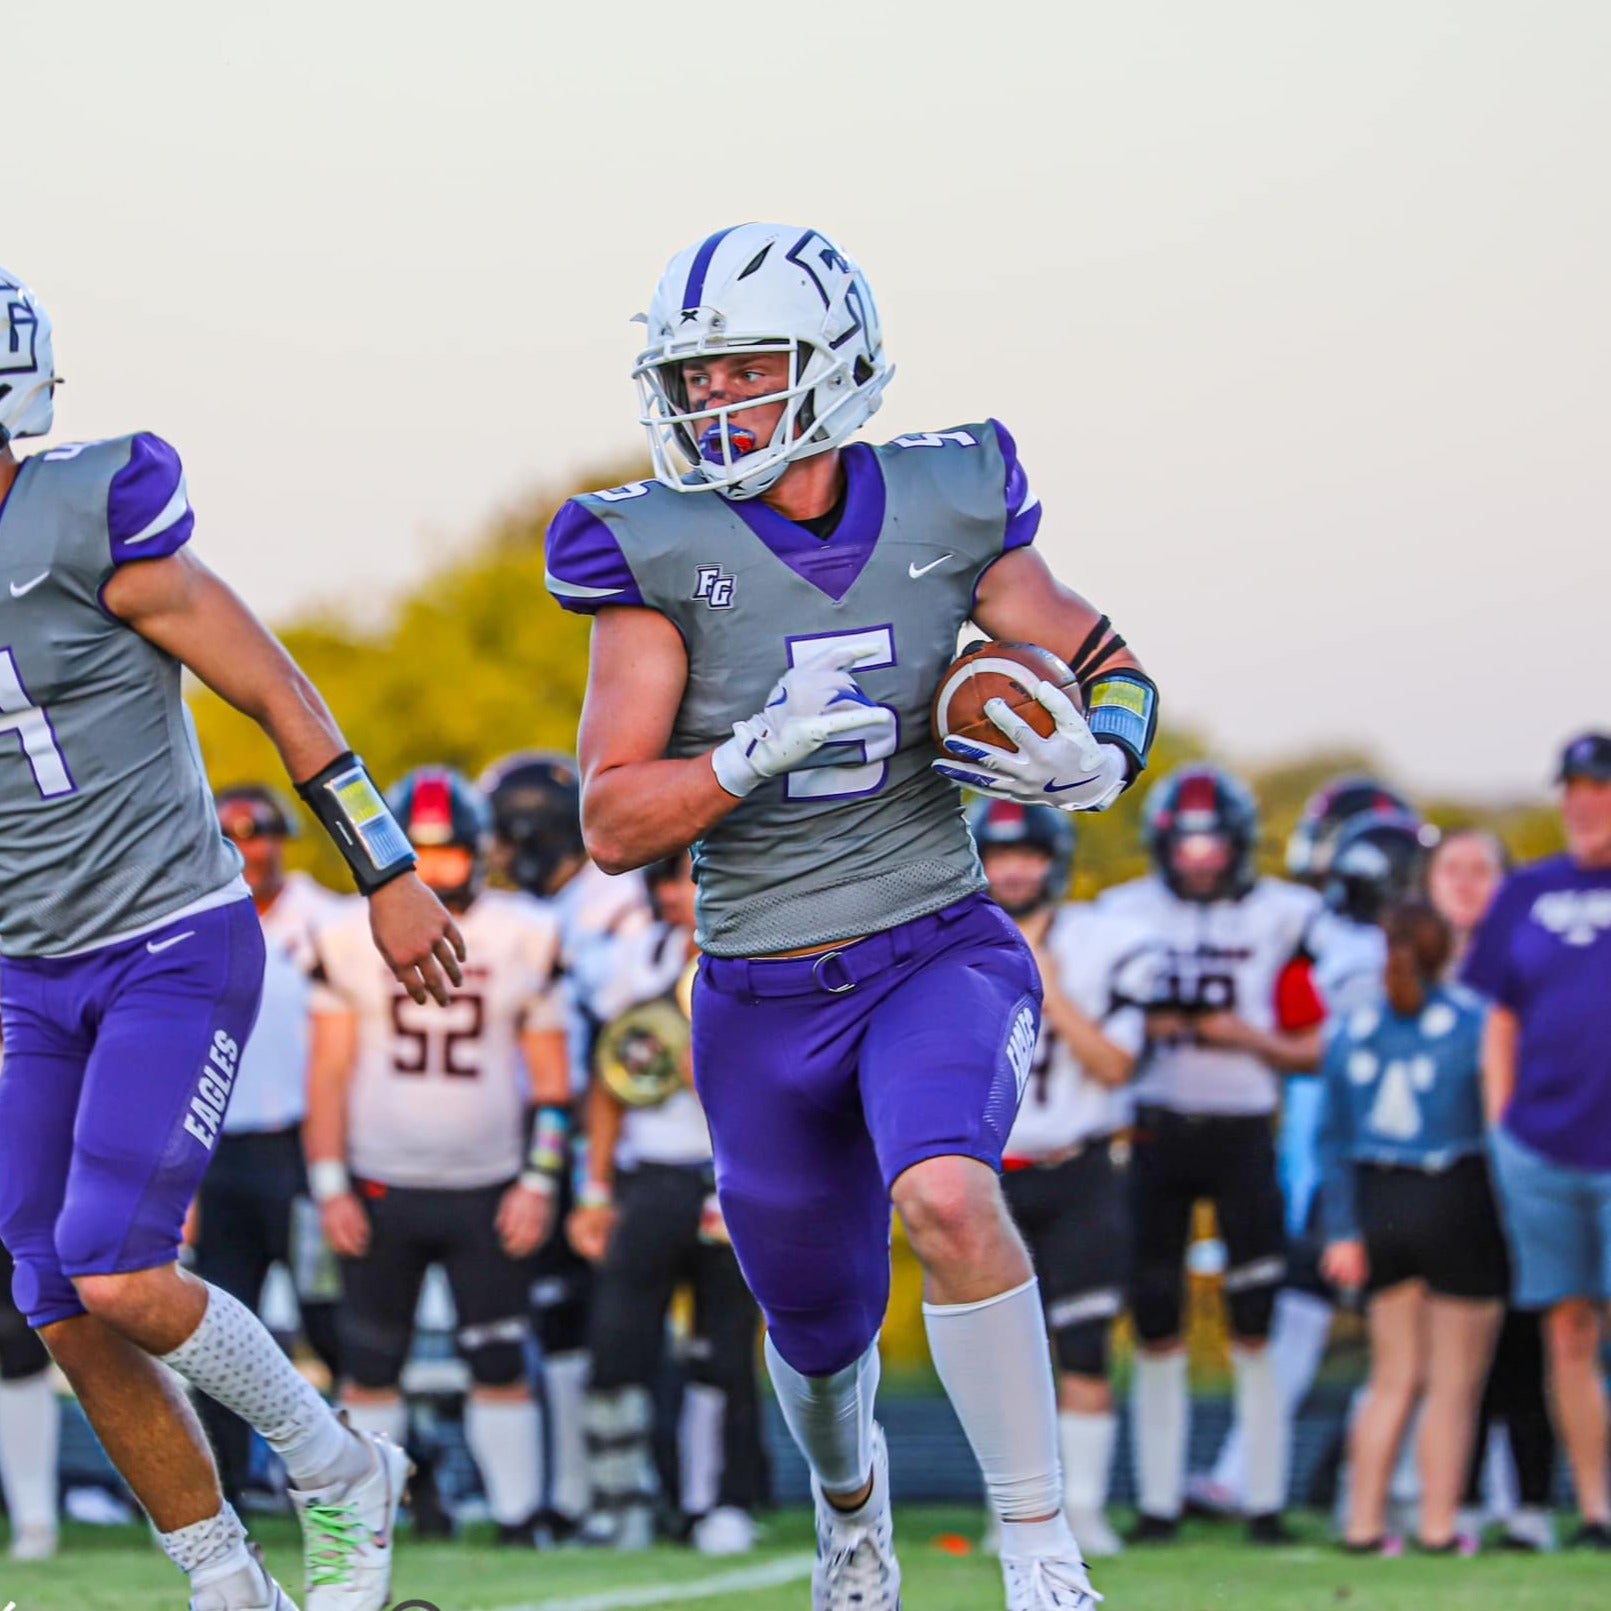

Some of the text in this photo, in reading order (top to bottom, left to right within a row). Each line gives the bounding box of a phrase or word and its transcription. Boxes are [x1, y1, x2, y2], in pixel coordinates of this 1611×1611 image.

[691, 564, 737, 610] FG
[784, 622, 900, 802] 5
[391, 993, 484, 1078] 52
[183, 1029, 239, 1151] EAGLES
